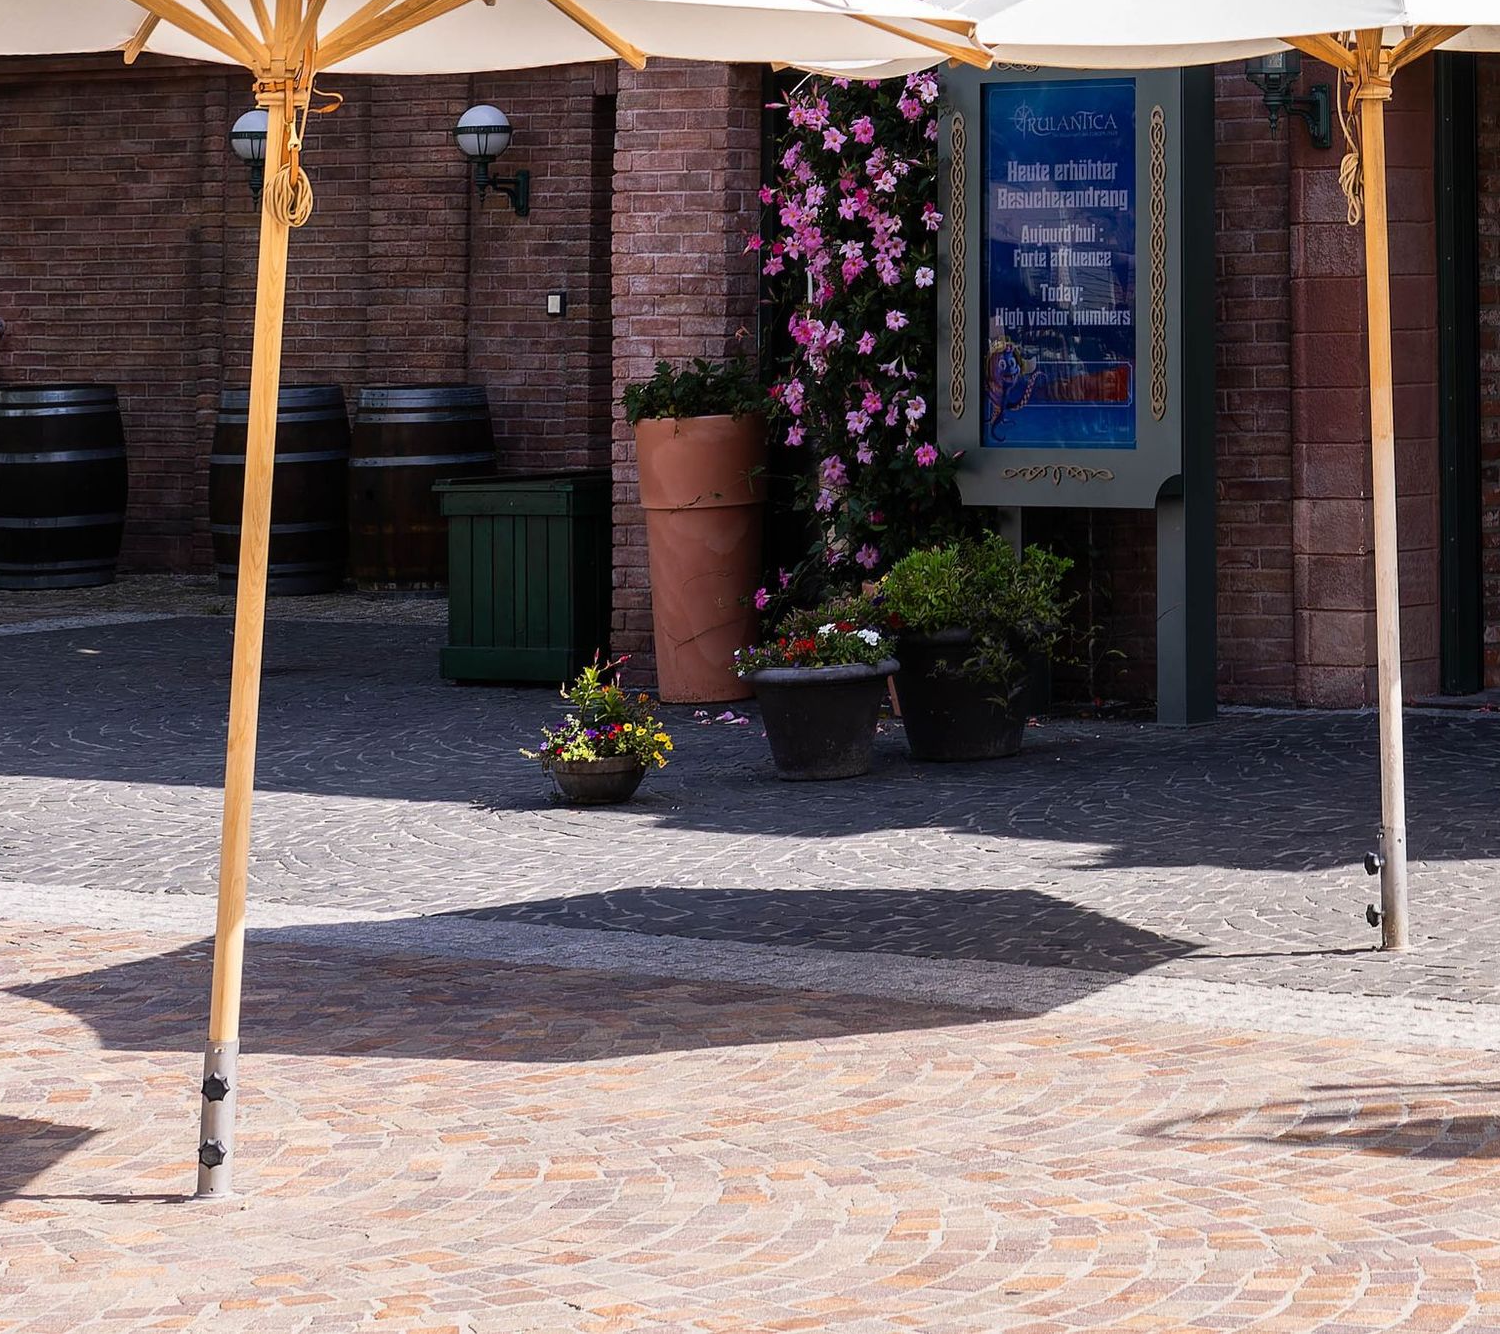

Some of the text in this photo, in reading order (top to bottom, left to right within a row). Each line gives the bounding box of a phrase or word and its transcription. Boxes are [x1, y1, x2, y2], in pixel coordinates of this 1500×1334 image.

[1028, 110, 1118, 137] RULANTICA
[1007, 158, 1118, 182] Heute erhöhter
[997, 186, 1129, 211] Besucherandrang
[1021, 223, 1096, 247] Aujourd'hui
[1013, 248, 1112, 268] Forte affluence
[1040, 283, 1084, 305] Today:
[995, 306, 1131, 330] High visitor numbers
